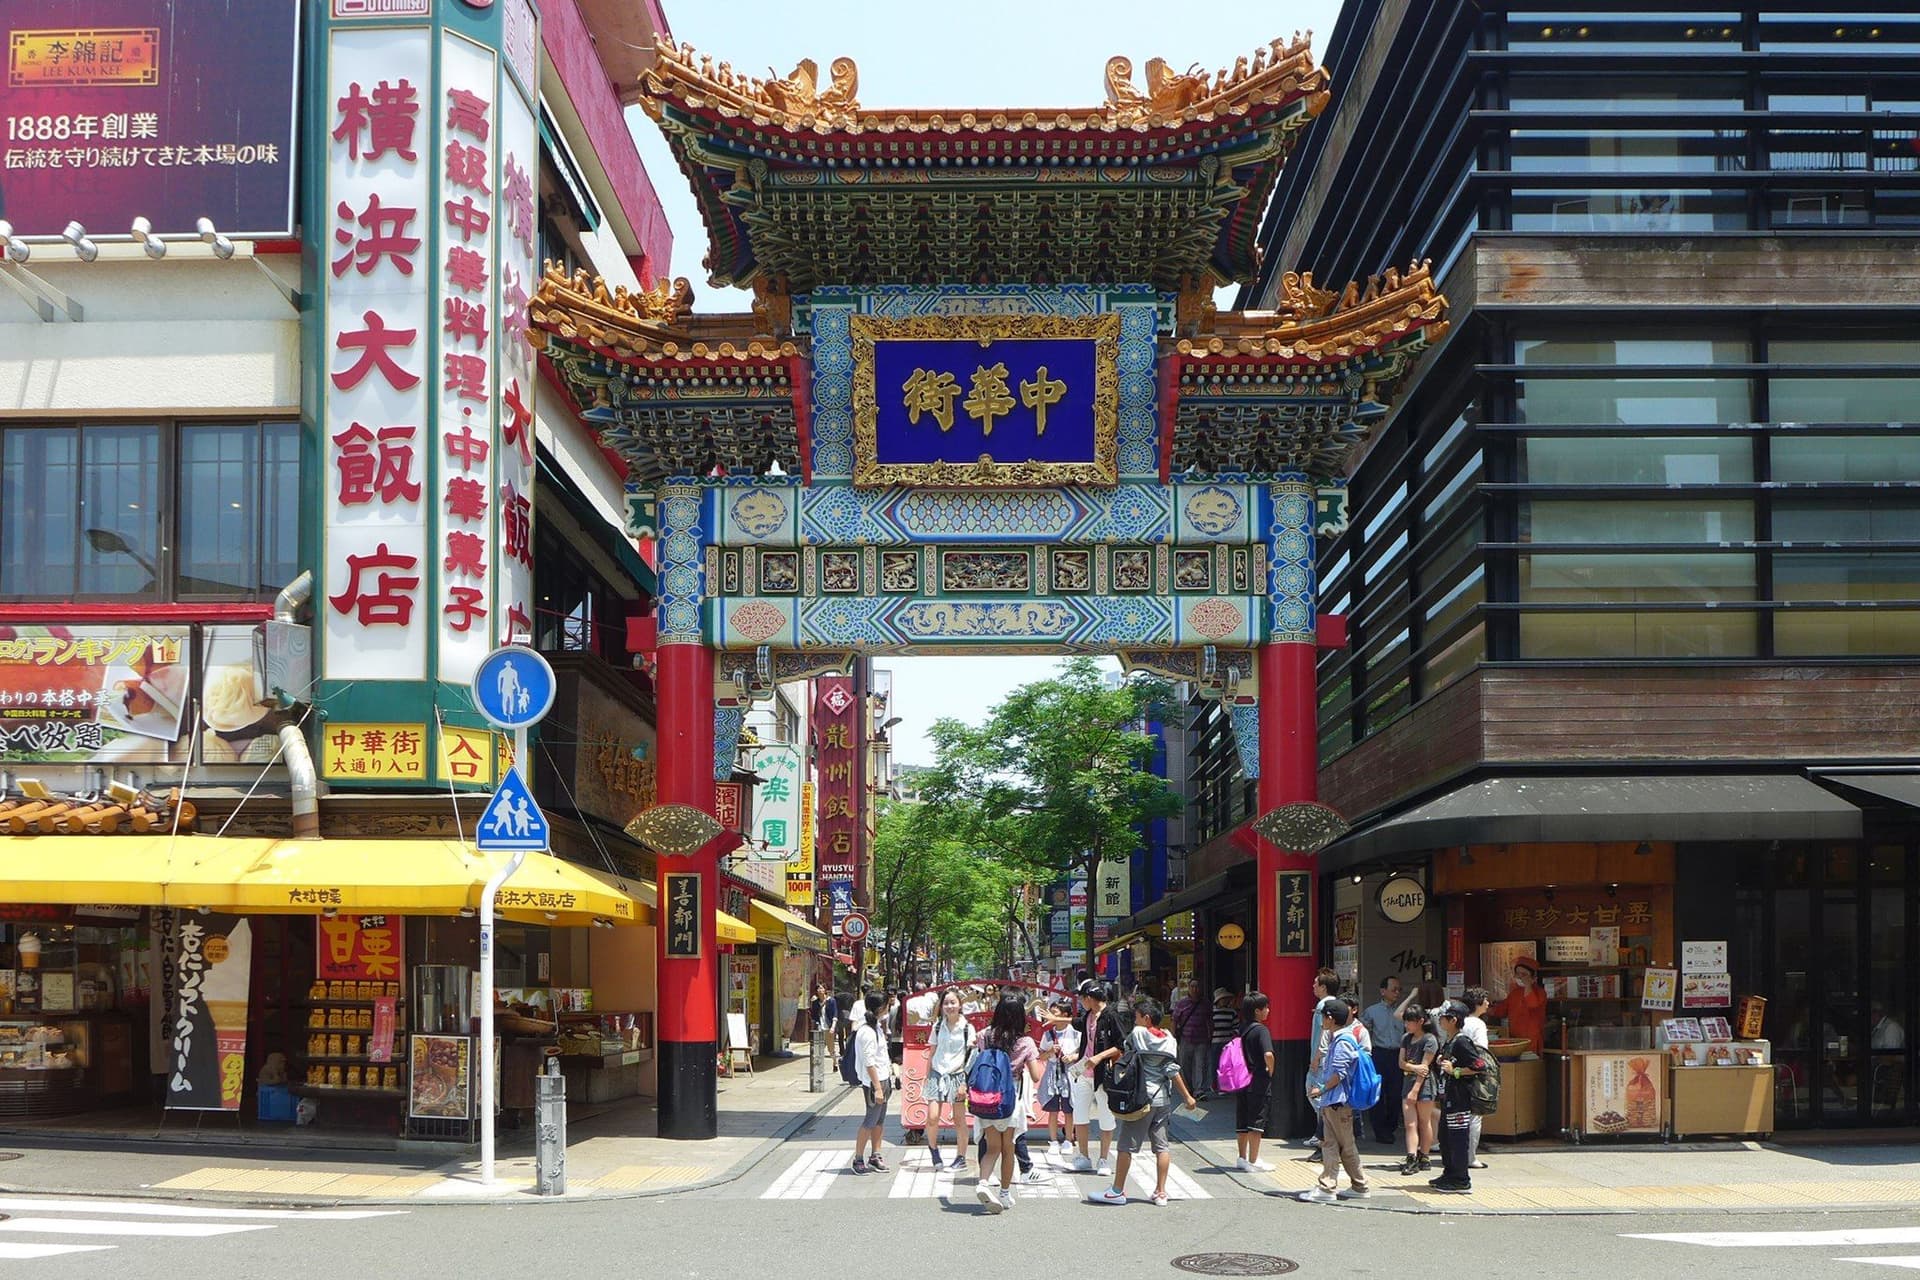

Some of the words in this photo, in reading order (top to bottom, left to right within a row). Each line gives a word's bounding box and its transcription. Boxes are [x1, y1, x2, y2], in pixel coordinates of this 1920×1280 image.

[45, 40, 123, 64] 李錦記
[43, 65, 63, 77] LEE
[67, 65, 97, 77] KUM
[100, 65, 122, 76] KEE
[6, 112, 159, 141] 1888年創業
[4, 143, 280, 169] 伝統を守り続けてきた本場の味
[328, 78, 422, 627] 横浜大飯店
[444, 87, 492, 633] 高級中華料理・中華菓子
[901, 360, 1068, 437] 中華街
[158, 646, 177, 662] 1位
[830, 691, 847, 708] 福
[331, 729, 421, 756] 中華街
[332, 757, 420, 774] 大通り入口
[448, 733, 483, 778] 入口
[824, 723, 856, 855] 龍州飯店
[761, 776, 791, 847] 楽園
[822, 865, 855, 873] RYUSYU
[788, 882, 812, 892] 100円
[1398, 893, 1422, 907] CAFE
[846, 921, 863, 935] 30
